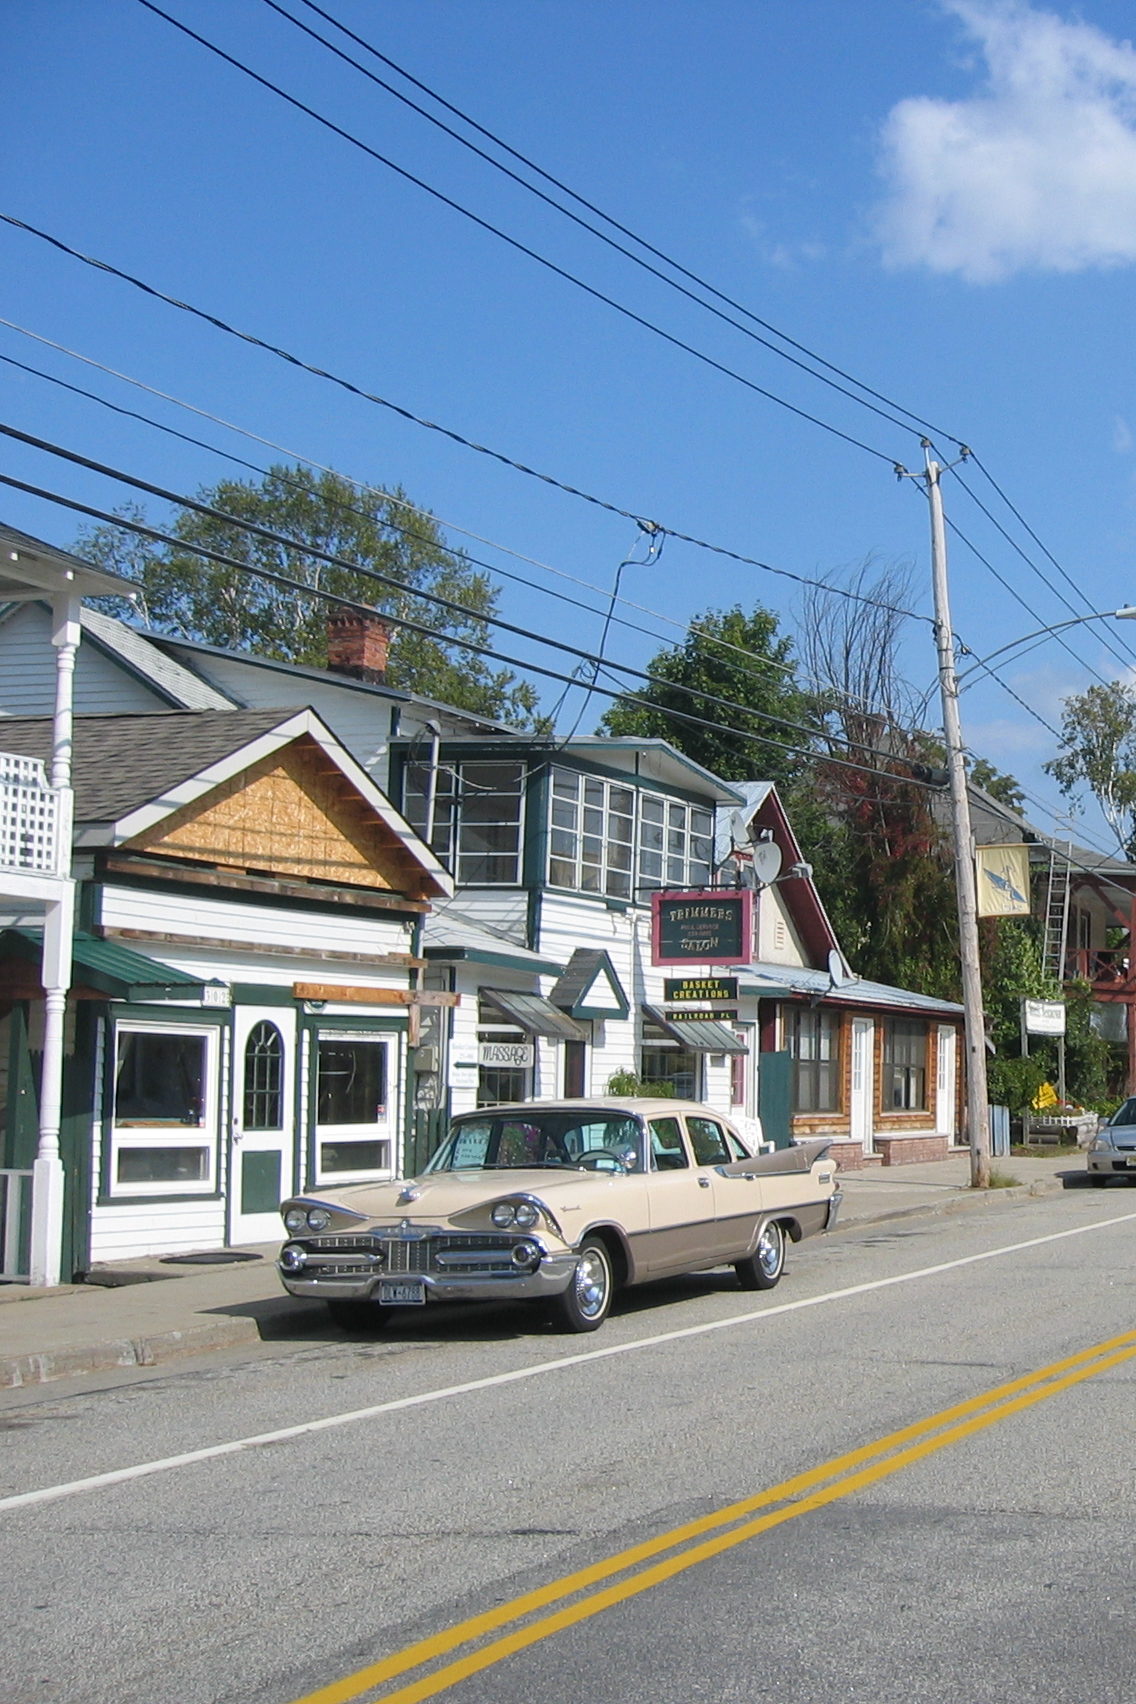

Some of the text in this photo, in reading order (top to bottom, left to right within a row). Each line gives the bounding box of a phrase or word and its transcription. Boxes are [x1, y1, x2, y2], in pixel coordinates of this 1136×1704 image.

[669, 907, 733, 921] TRIMMERS
[681, 937, 719, 951] SALON
[682, 981, 720, 989] BASKET
[673, 990, 729, 999] CREATIONS
